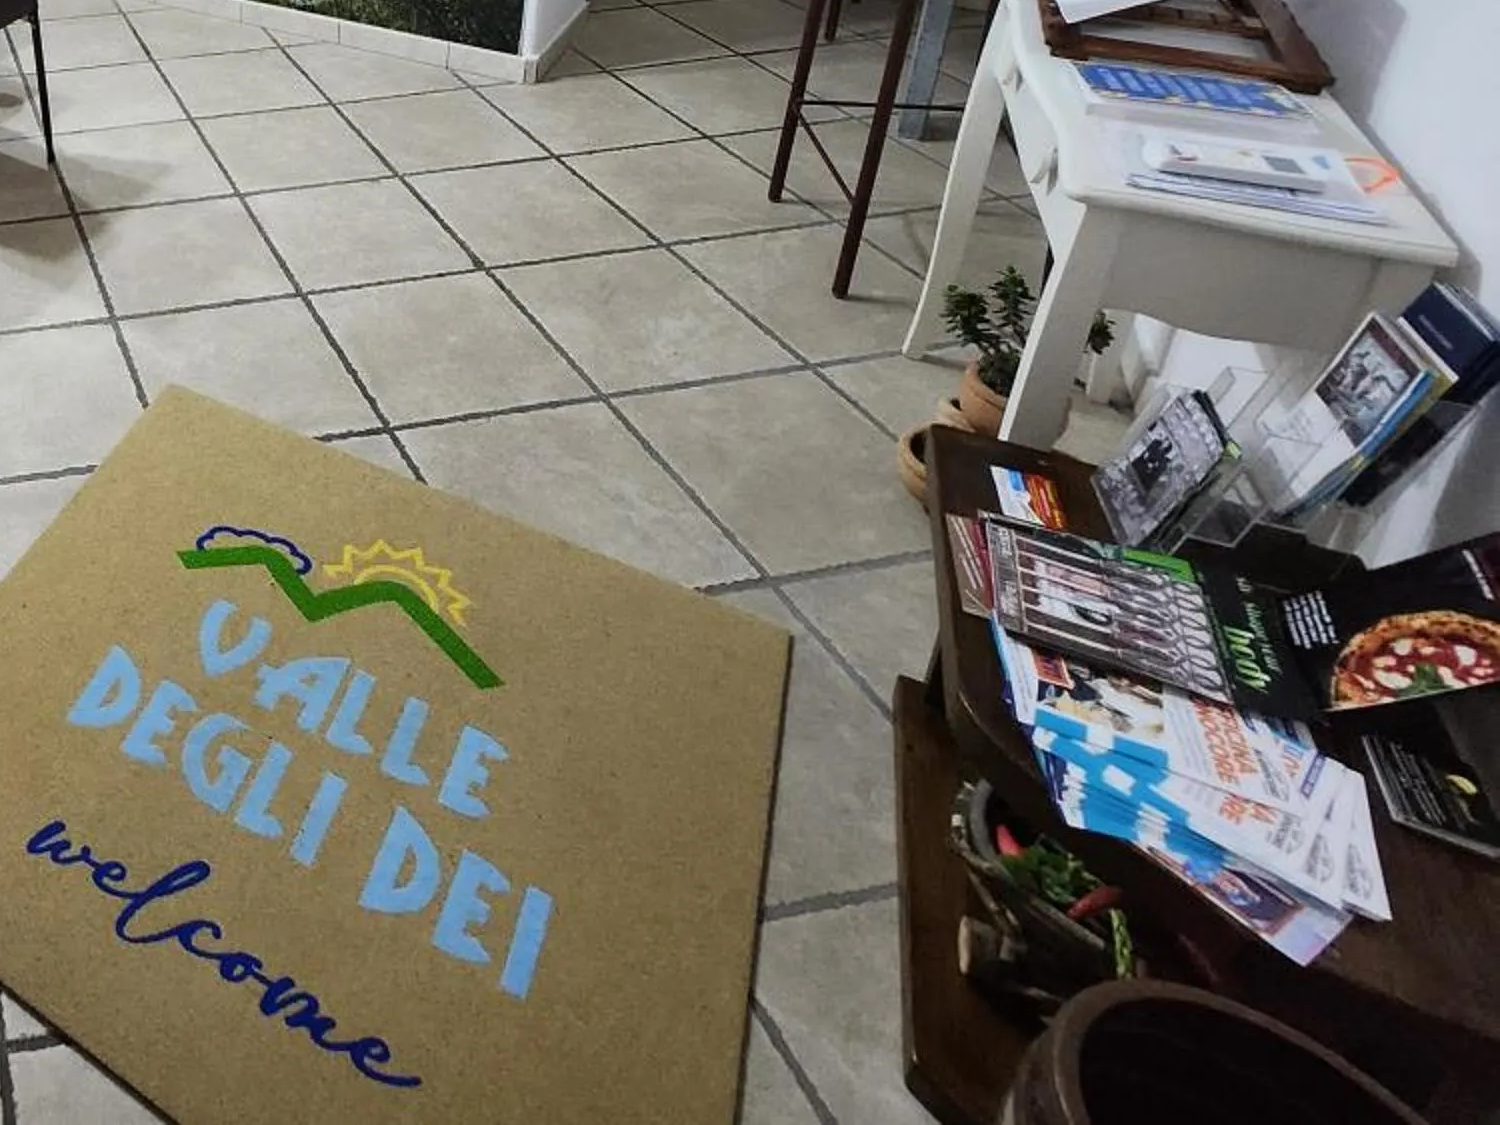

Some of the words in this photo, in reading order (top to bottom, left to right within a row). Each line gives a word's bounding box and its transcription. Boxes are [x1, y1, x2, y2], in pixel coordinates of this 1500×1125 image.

[69, 646, 347, 865] DEGLI
[359, 807, 552, 998] DEI
[199, 601, 508, 817] VALLE
[27, 819, 420, 1088] welcome
